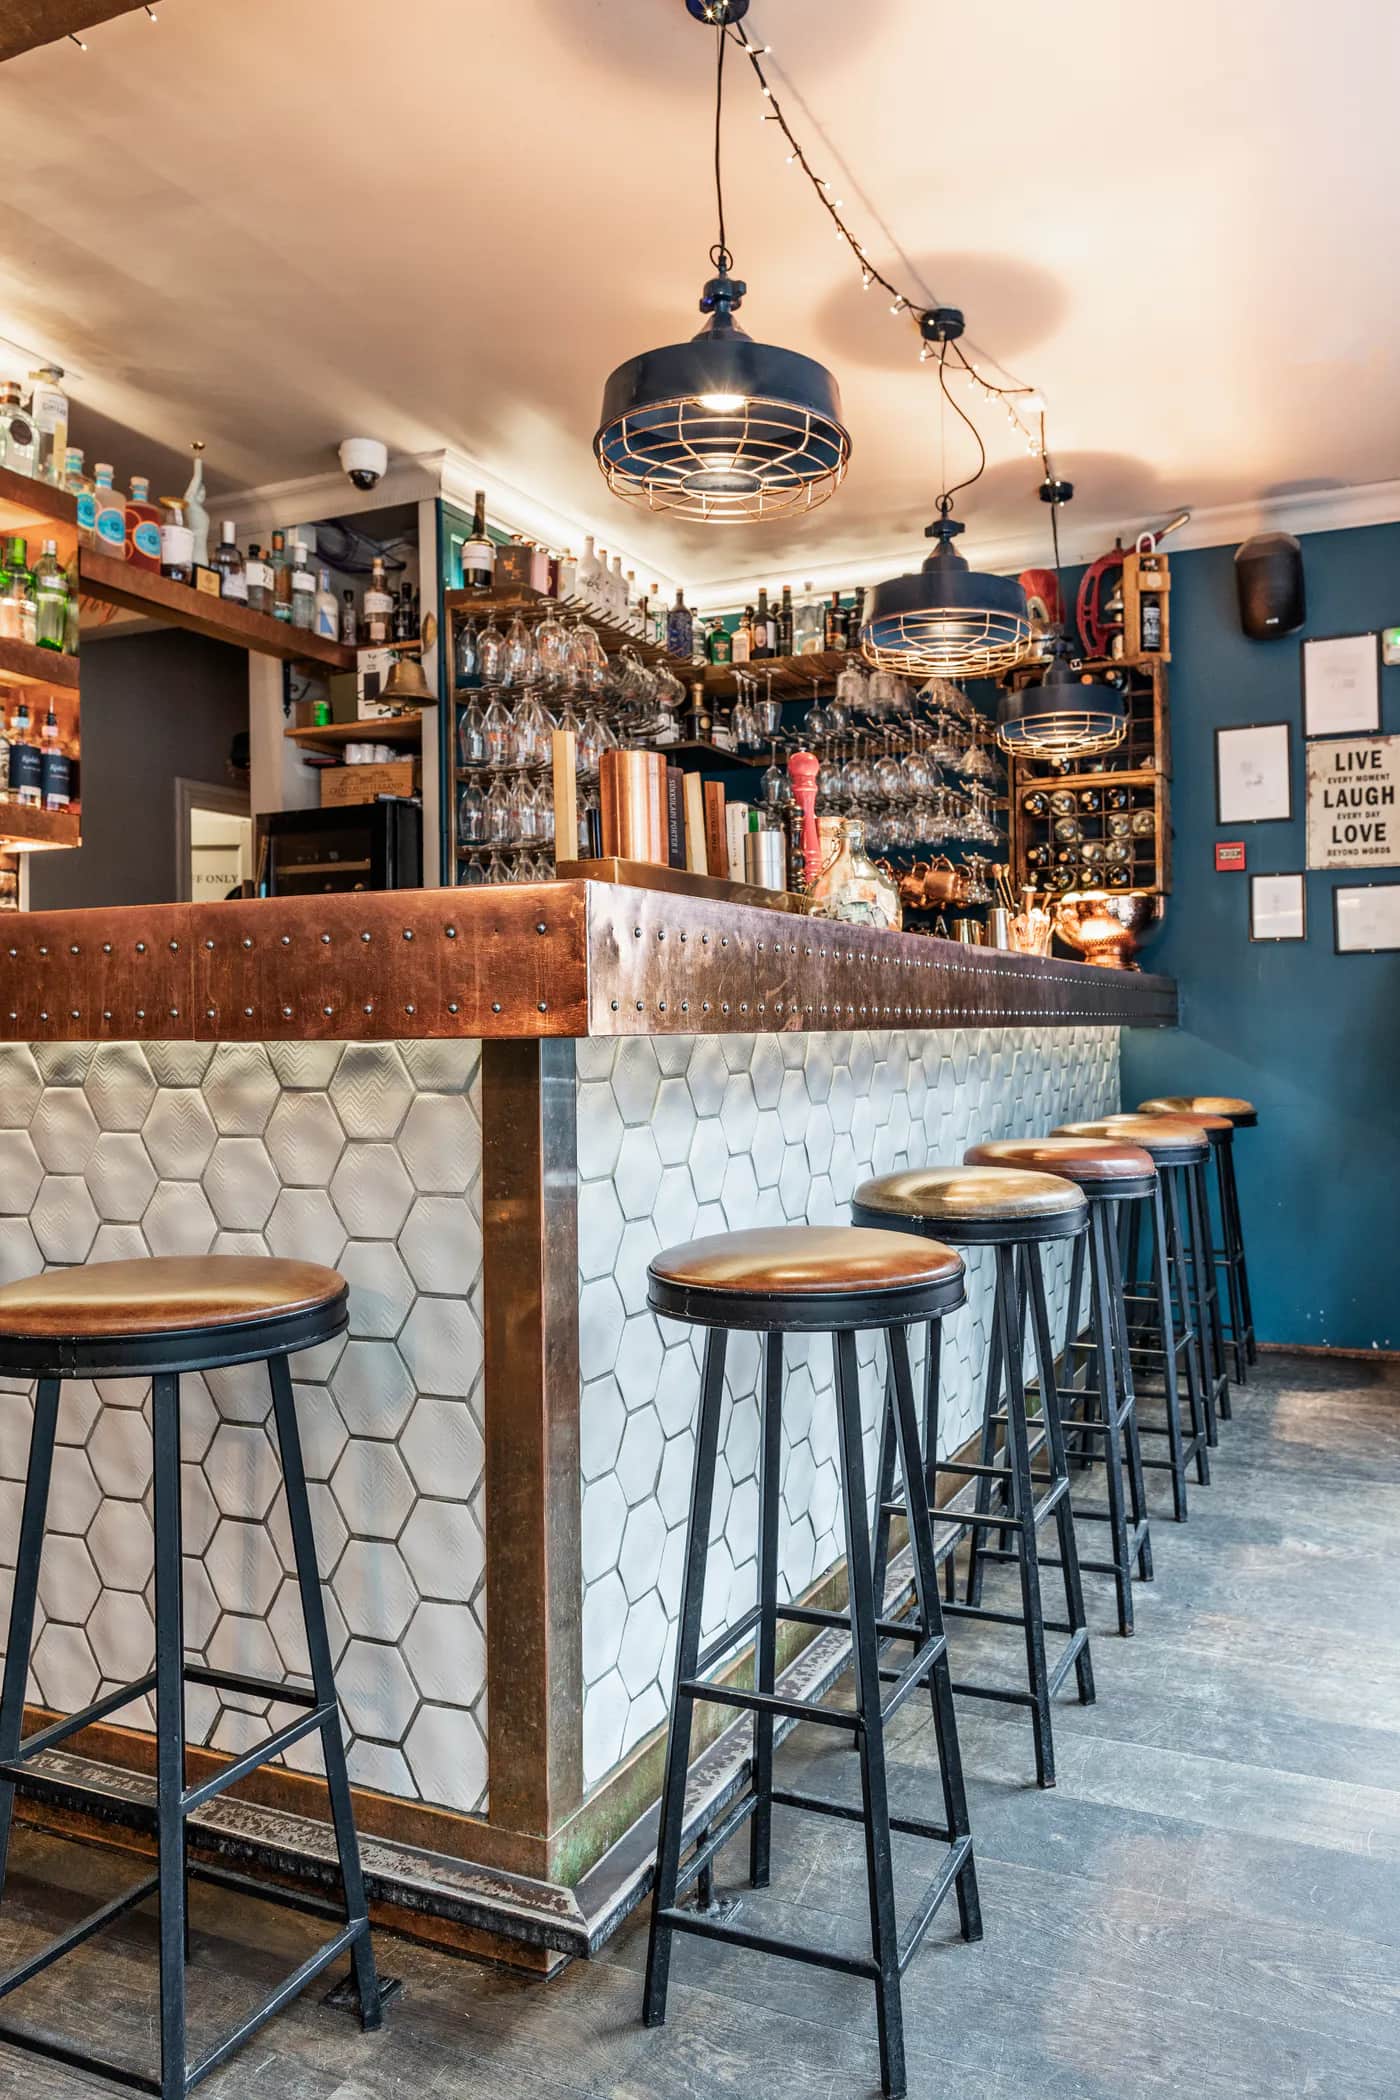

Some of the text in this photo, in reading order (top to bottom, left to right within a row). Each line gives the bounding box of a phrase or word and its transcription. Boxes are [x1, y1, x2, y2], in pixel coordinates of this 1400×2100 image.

[1335, 750, 1382, 771] LIVE
[1327, 773, 1390, 784] EVERY MOMENT
[1324, 786, 1394, 808] LAUGH
[1337, 811, 1380, 820] EVERY DAY
[1332, 823, 1386, 844] LOVE
[1327, 846, 1391, 856] BEYOND WORDS
[206, 874, 239, 884] ONLY
